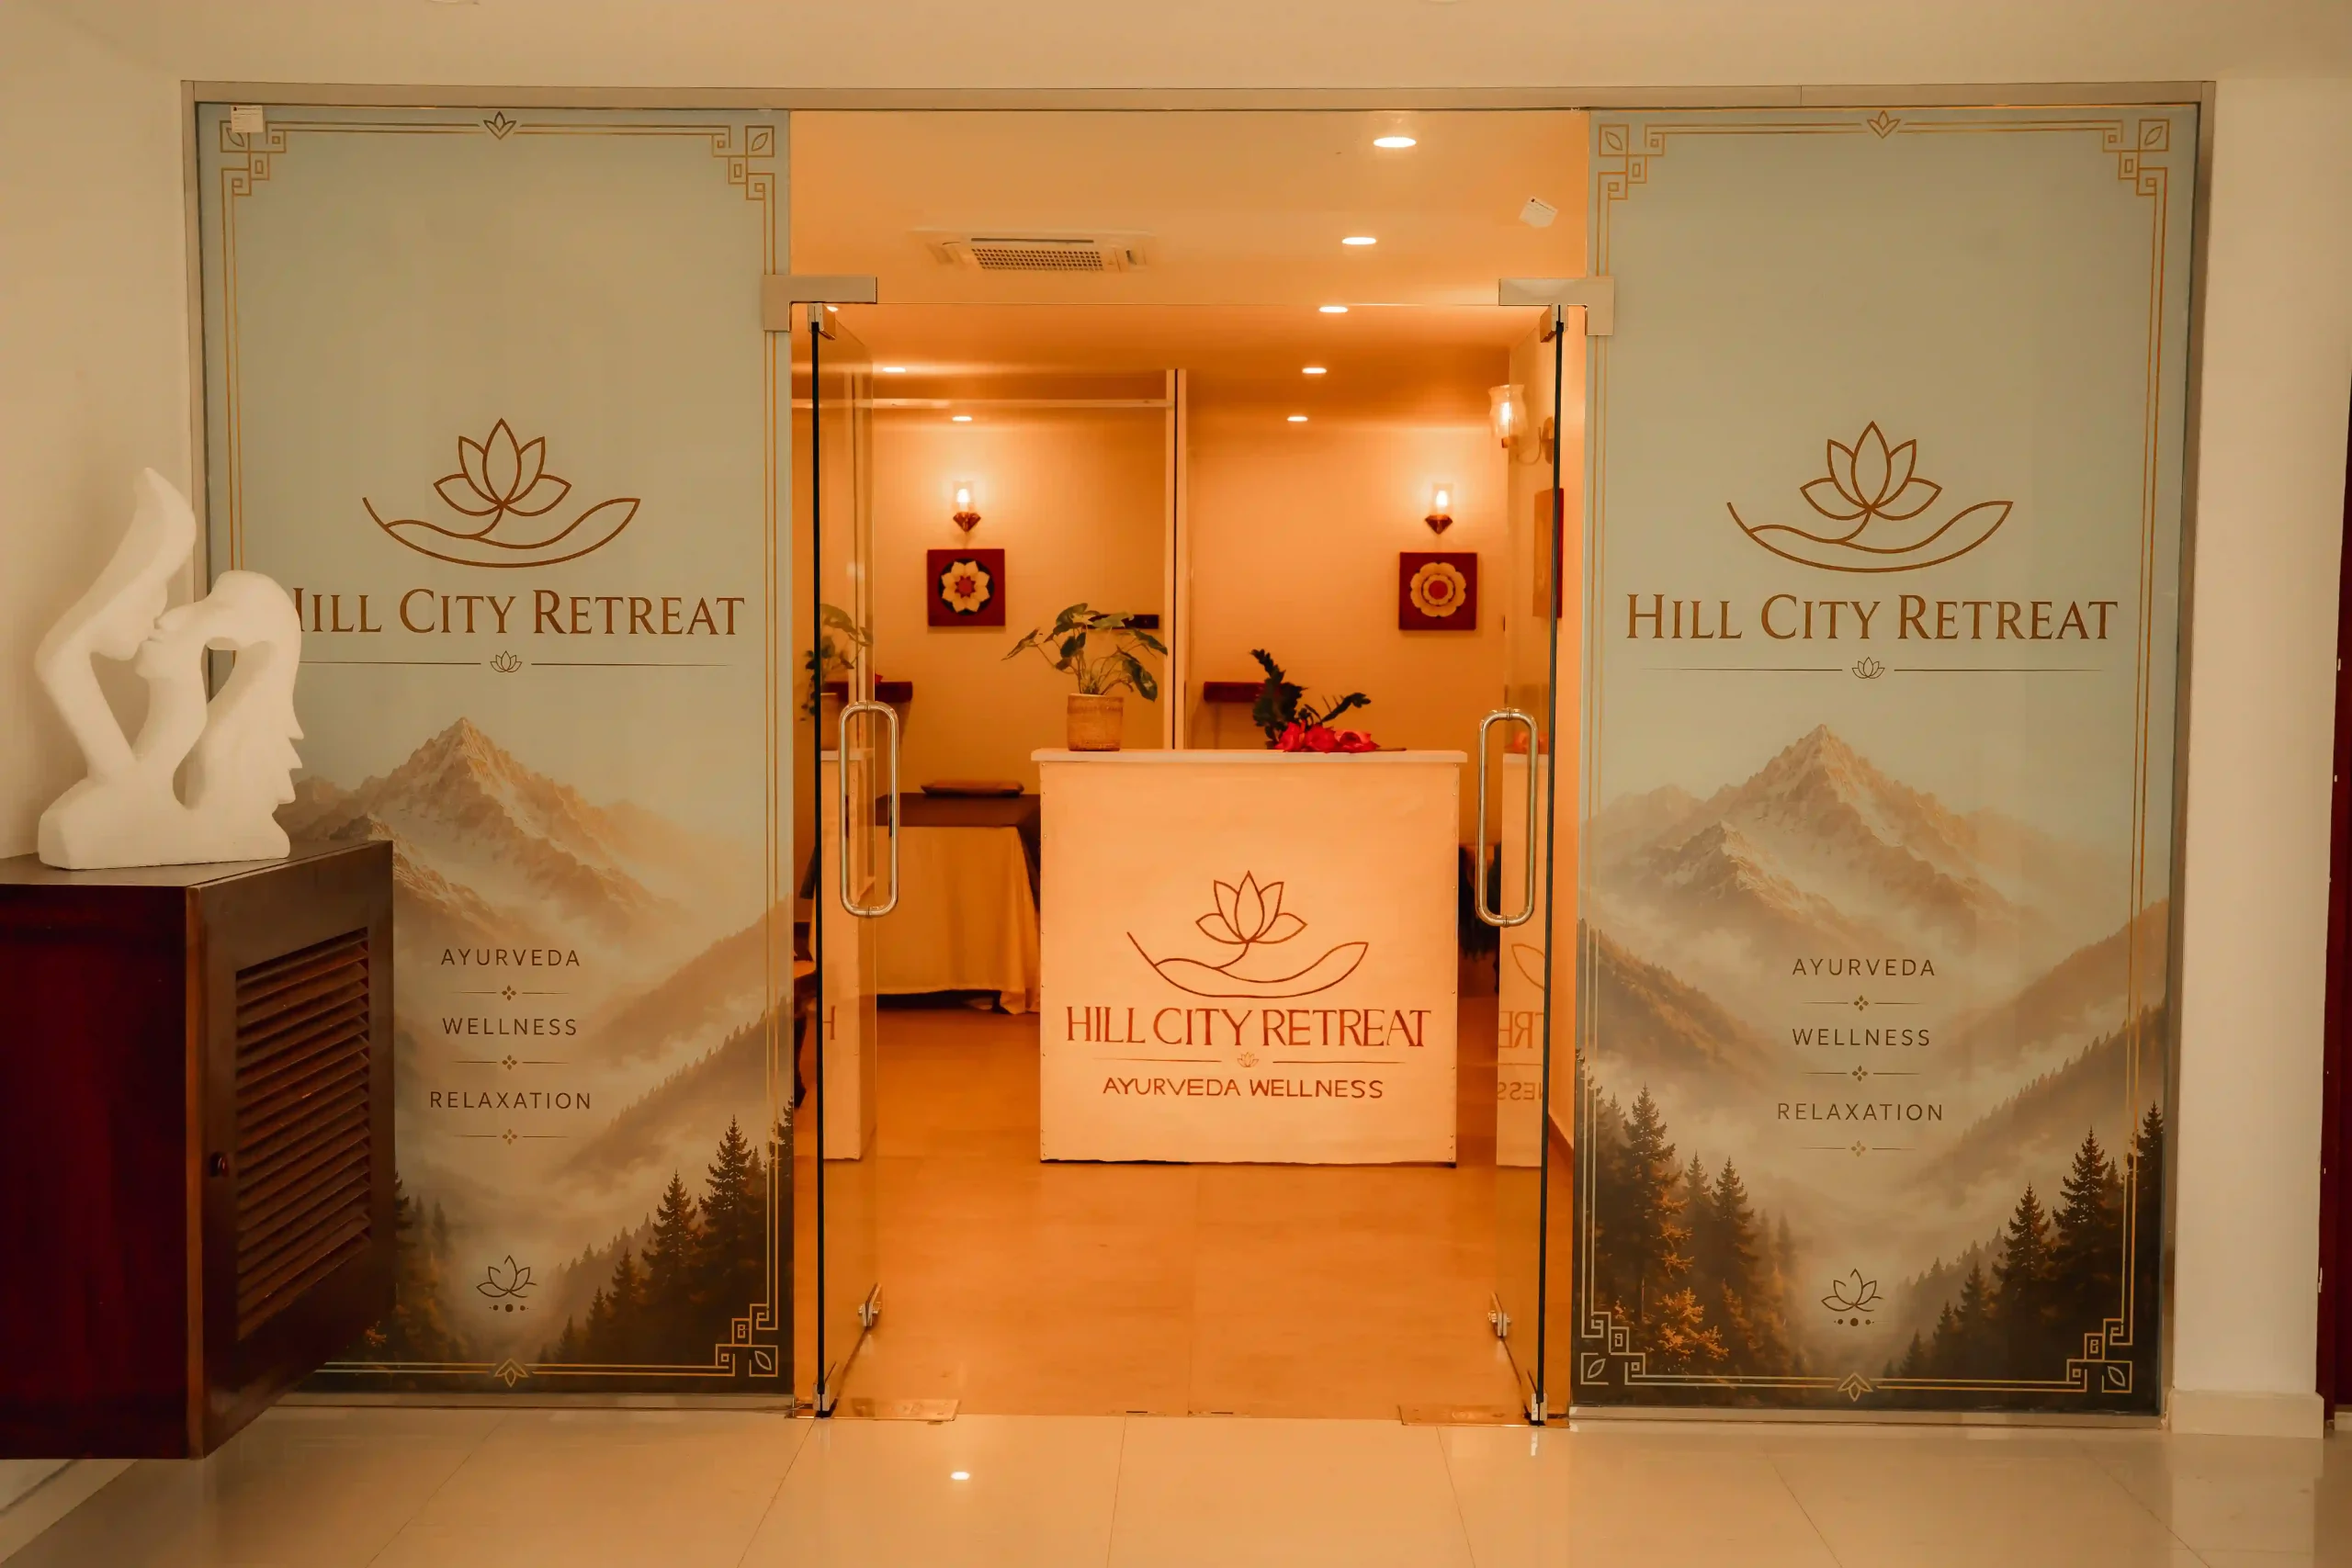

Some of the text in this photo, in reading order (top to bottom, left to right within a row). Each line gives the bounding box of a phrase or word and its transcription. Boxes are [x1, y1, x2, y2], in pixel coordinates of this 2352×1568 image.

[399, 588, 517, 635] CITY
[532, 589, 746, 637] RETREAT
[1626, 593, 2119, 641] HILL CITY RETREAT
[440, 947, 582, 967] AYURVEDA
[1792, 957, 1936, 977] AYURVEDA
[441, 1017, 578, 1036] WELLNESS
[1066, 1005, 1432, 1049] HILL CITY RETREAT
[1792, 1028, 1931, 1047] WELLNESS
[1102, 1077, 1385, 1100] AYURVEDA WELLNESS
[430, 1090, 592, 1110] RELAXATION
[1777, 1102, 1943, 1122] RELAXATION
